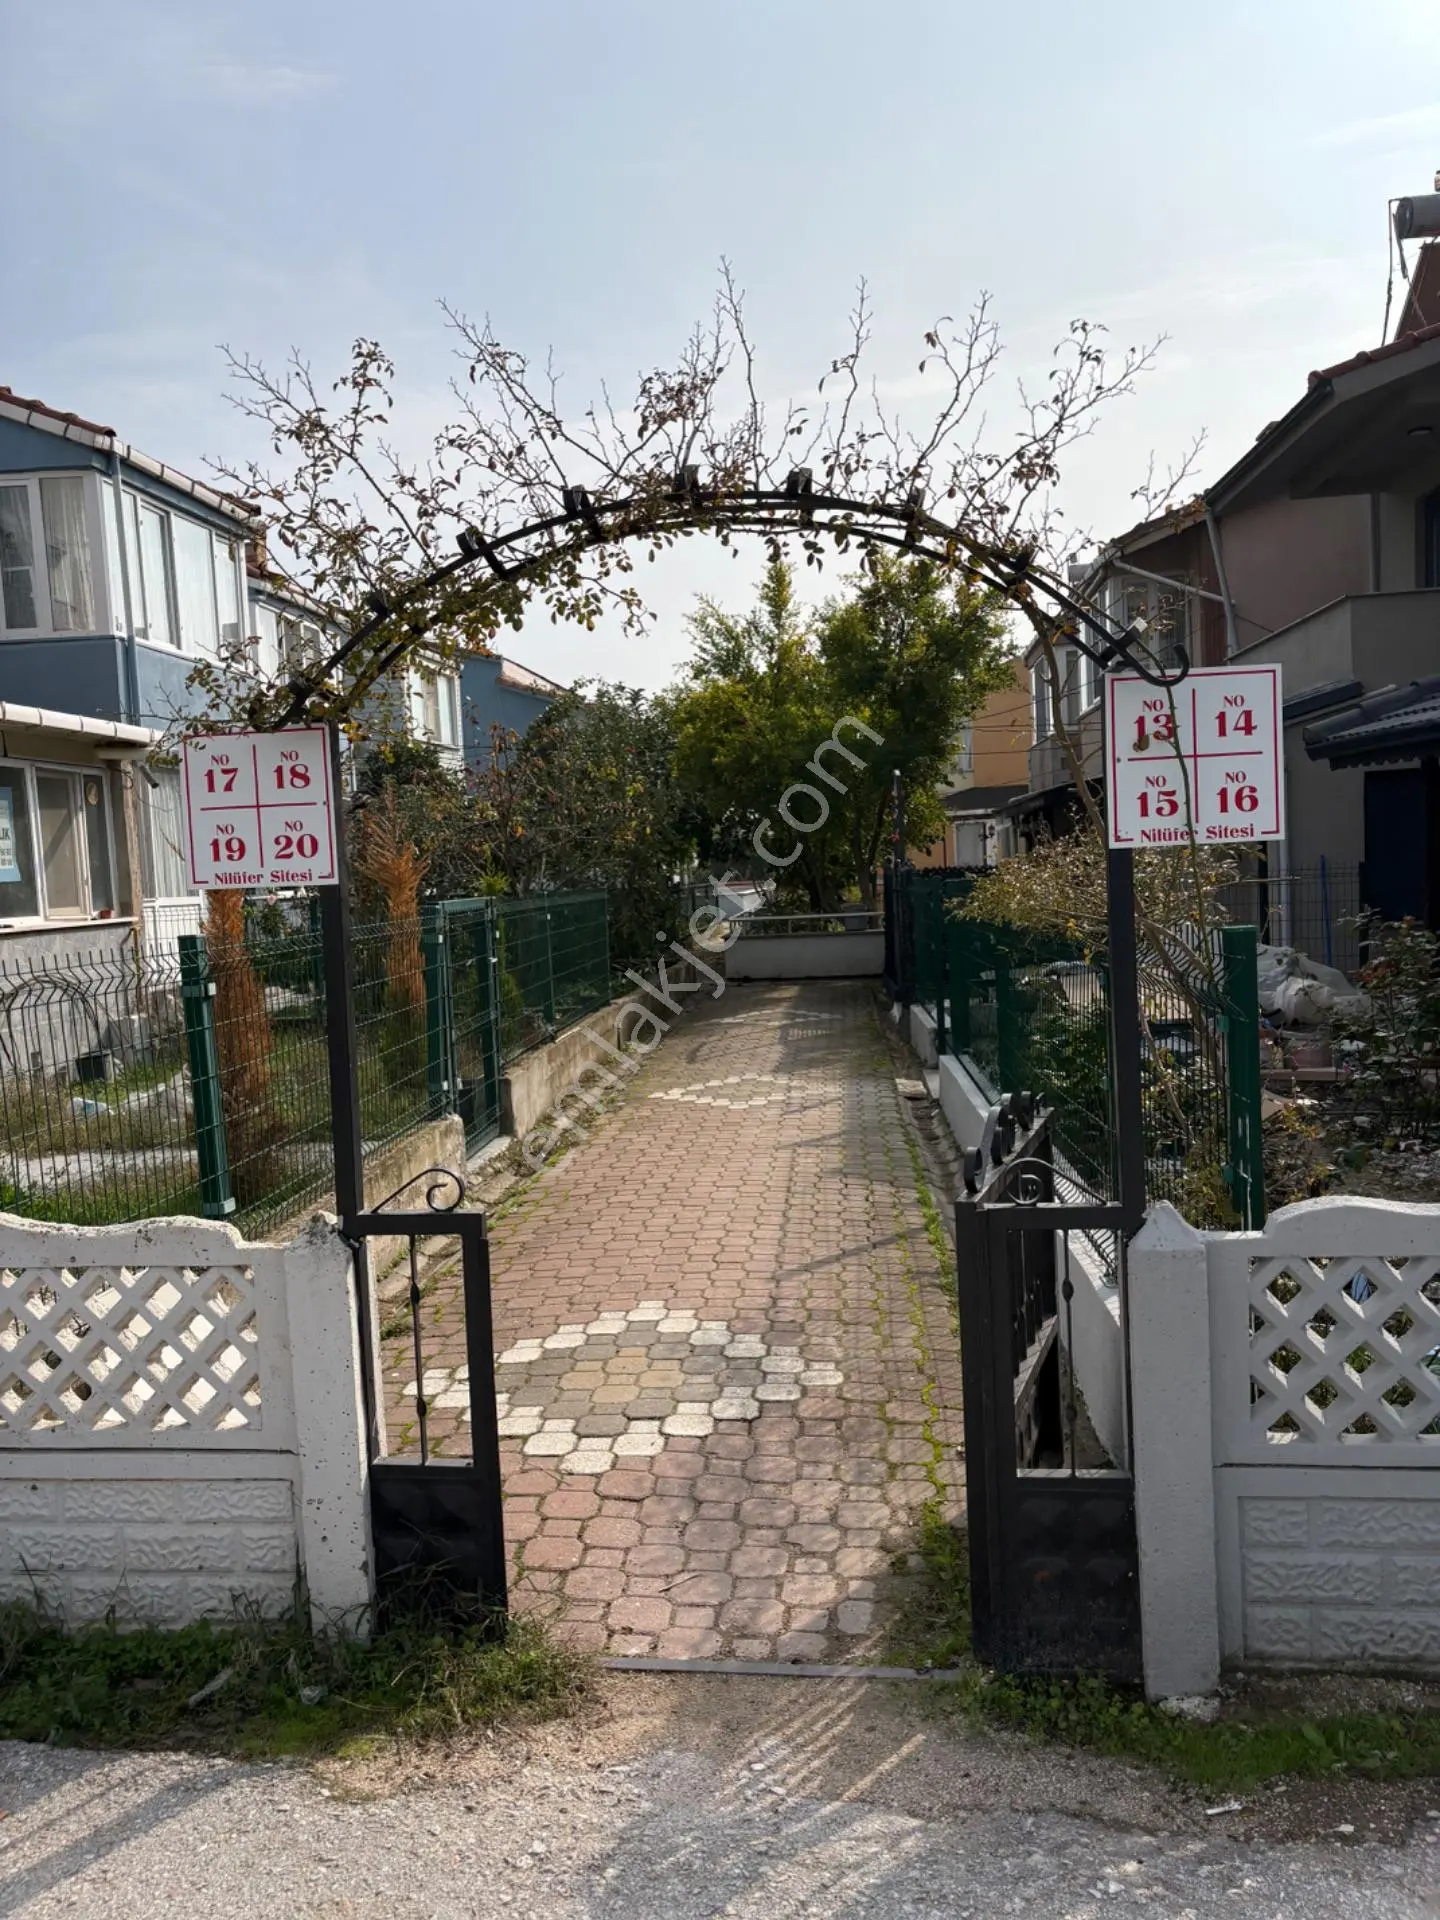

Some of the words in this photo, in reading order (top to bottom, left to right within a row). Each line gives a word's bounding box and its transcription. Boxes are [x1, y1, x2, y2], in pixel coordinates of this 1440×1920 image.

[1142, 699, 1164, 712] NO
[1223, 695, 1245, 707] NO
[1134, 713, 1175, 742] 13
[1215, 710, 1258, 738] 14
[210, 754, 230, 766] NO
[280, 750, 299, 762] NO
[204, 767, 239, 793] 17
[273, 763, 311, 790] 18
[1145, 775, 1167, 788] NO
[1225, 771, 1247, 783] NO
[1137, 789, 1179, 818] 15
[1216, 785, 1259, 813] 16
[216, 823, 235, 835] NO
[284, 820, 304, 832] NO
[1205, 823, 1255, 840] Sitesi
[209, 836, 246, 863] 19
[273, 833, 319, 860] 20
[214, 871, 264, 885] Nilüfer
[270, 868, 313, 883] Sitesi
